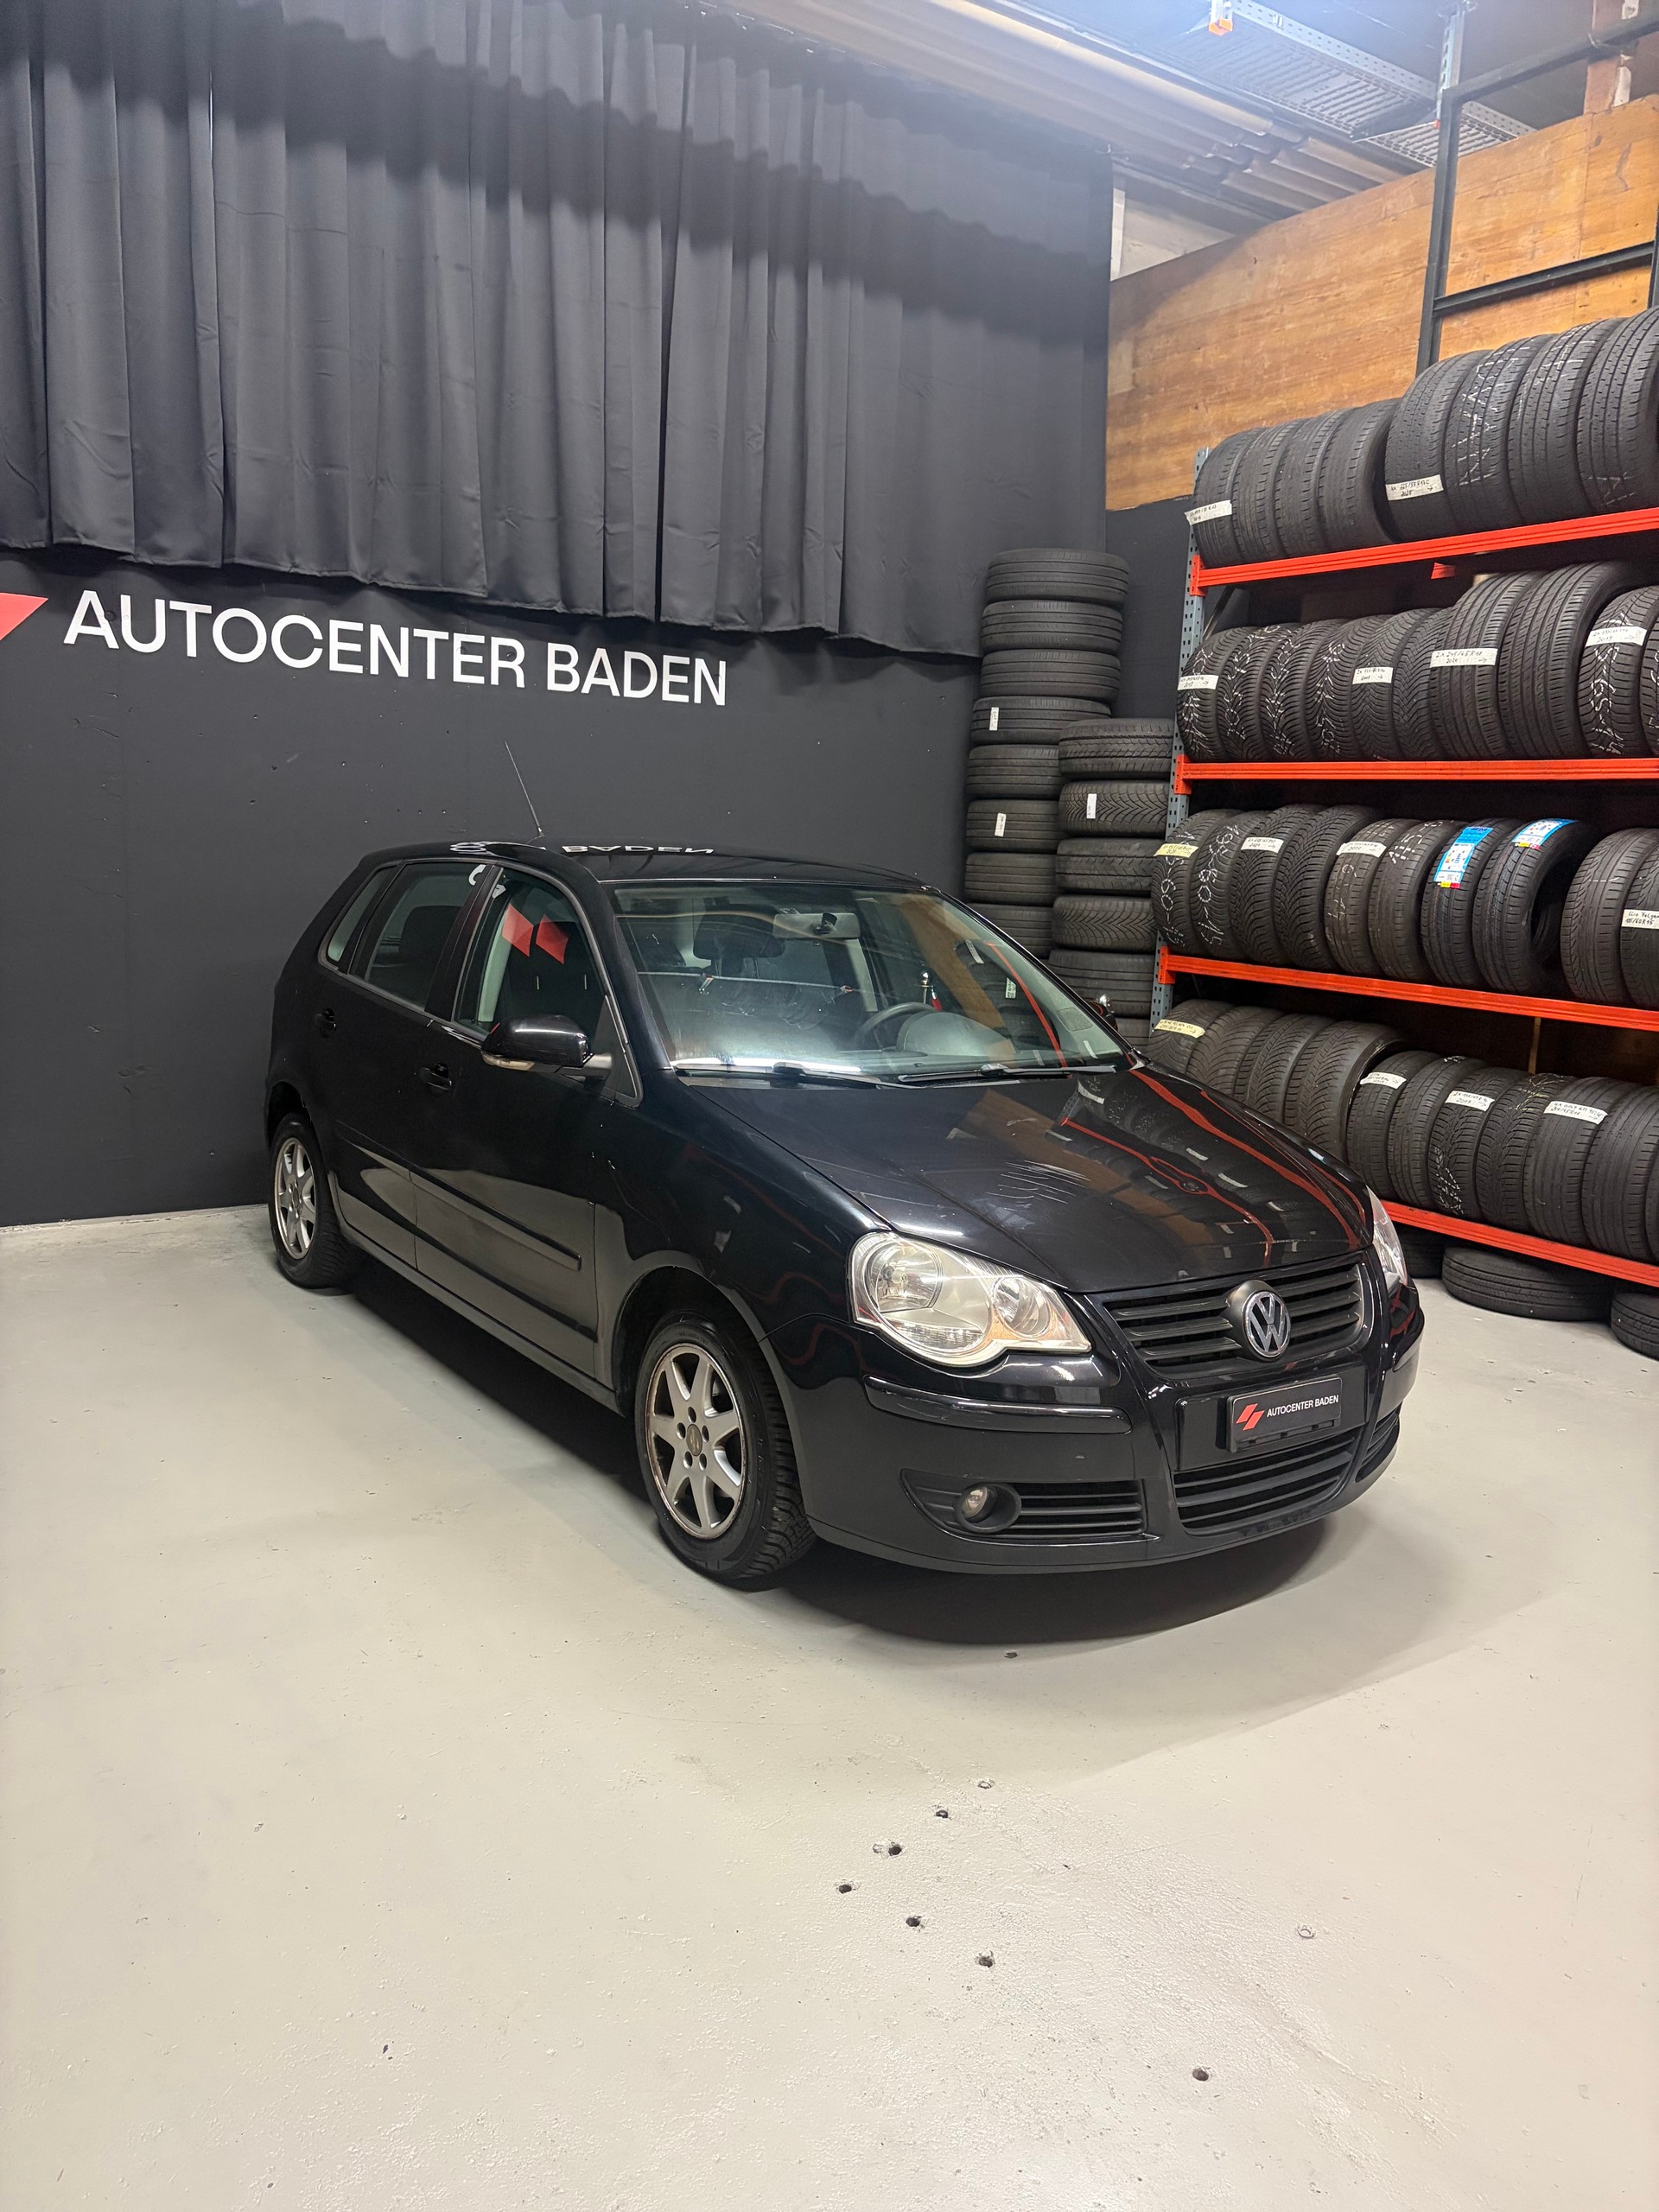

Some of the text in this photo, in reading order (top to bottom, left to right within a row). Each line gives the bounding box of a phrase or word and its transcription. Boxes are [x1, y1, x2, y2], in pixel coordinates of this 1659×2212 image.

[63, 590, 726, 706] AUTOCENTER BADEN
[1246, 1292, 1290, 1357] VW
[1267, 1395, 1338, 1417] AUTOCENTER BADEN
